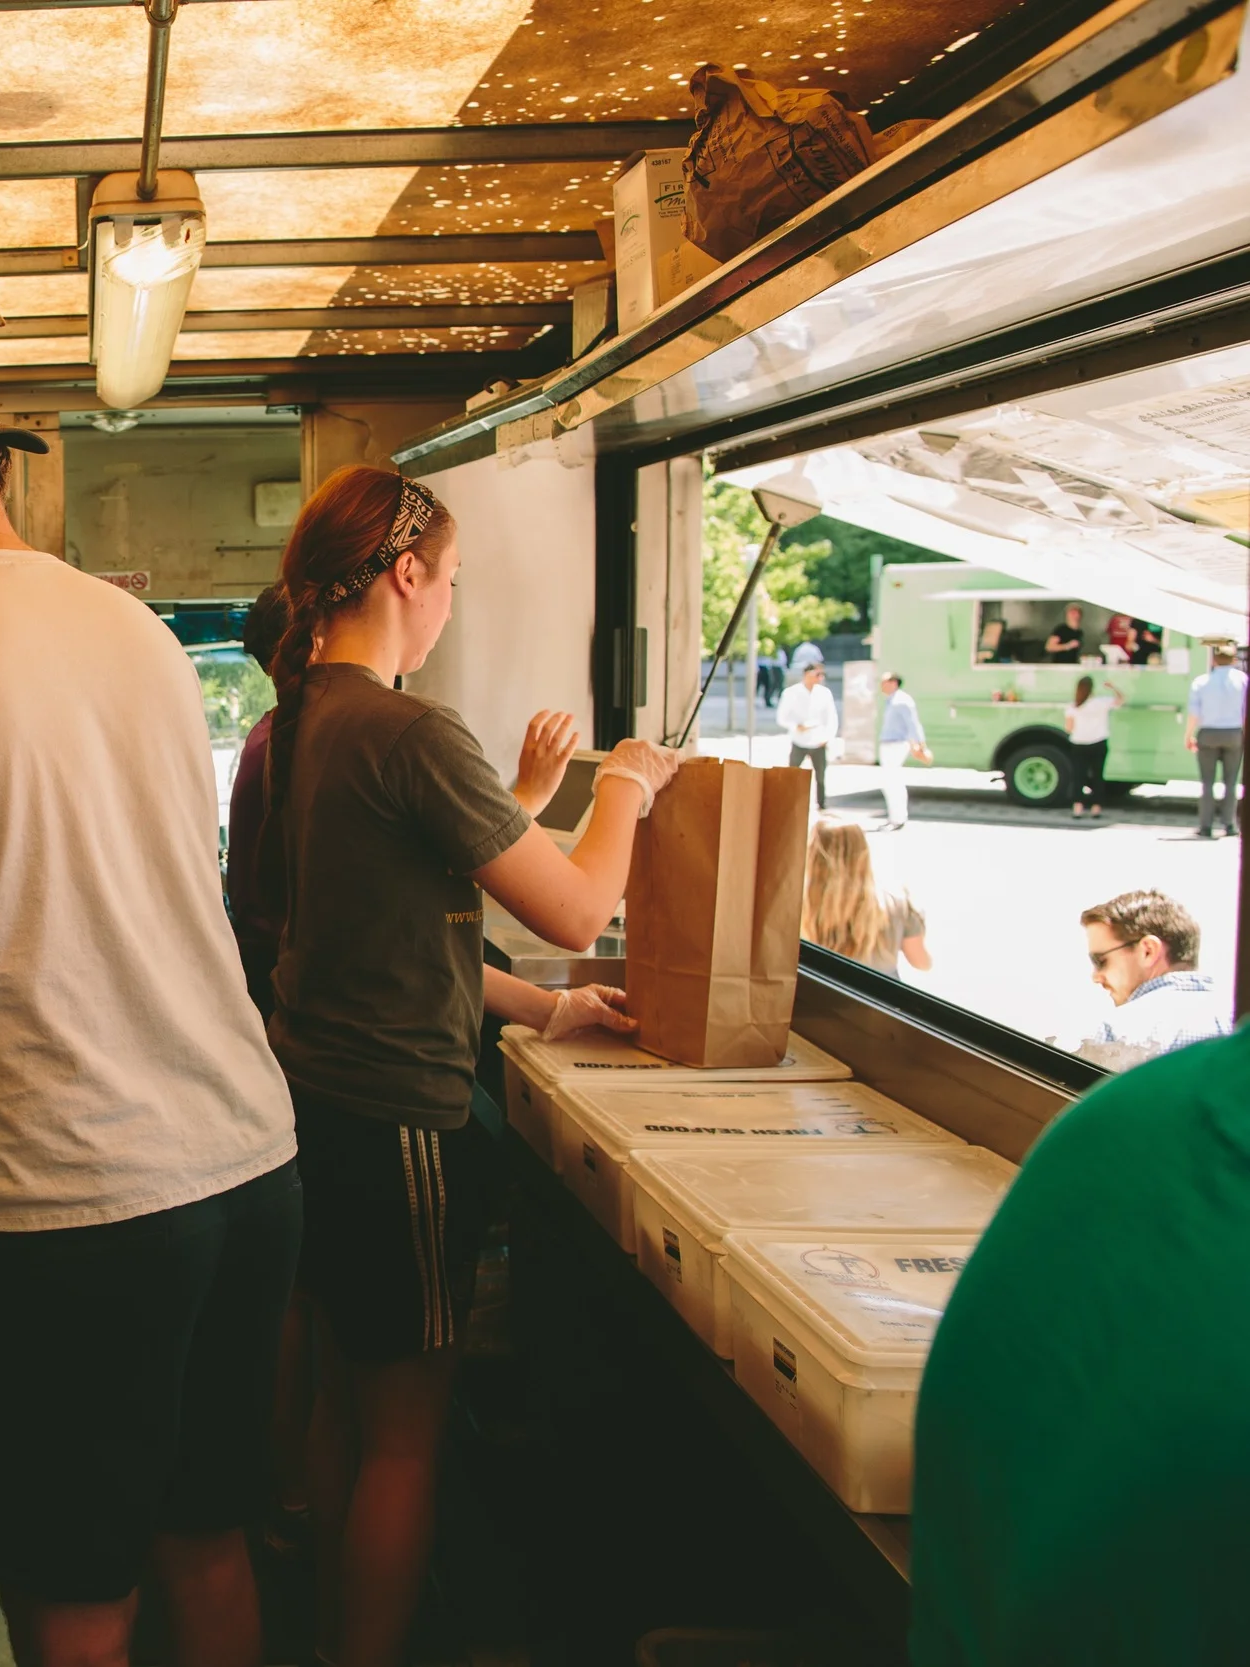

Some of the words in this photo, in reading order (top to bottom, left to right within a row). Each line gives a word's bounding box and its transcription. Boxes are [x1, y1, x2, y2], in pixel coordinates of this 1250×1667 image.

[664, 184, 684, 192] FIR
[644, 1124, 746, 1135] SEAFOOD
[750, 1128, 824, 1136] FRESH
[893, 1256, 967, 1274] FRES
